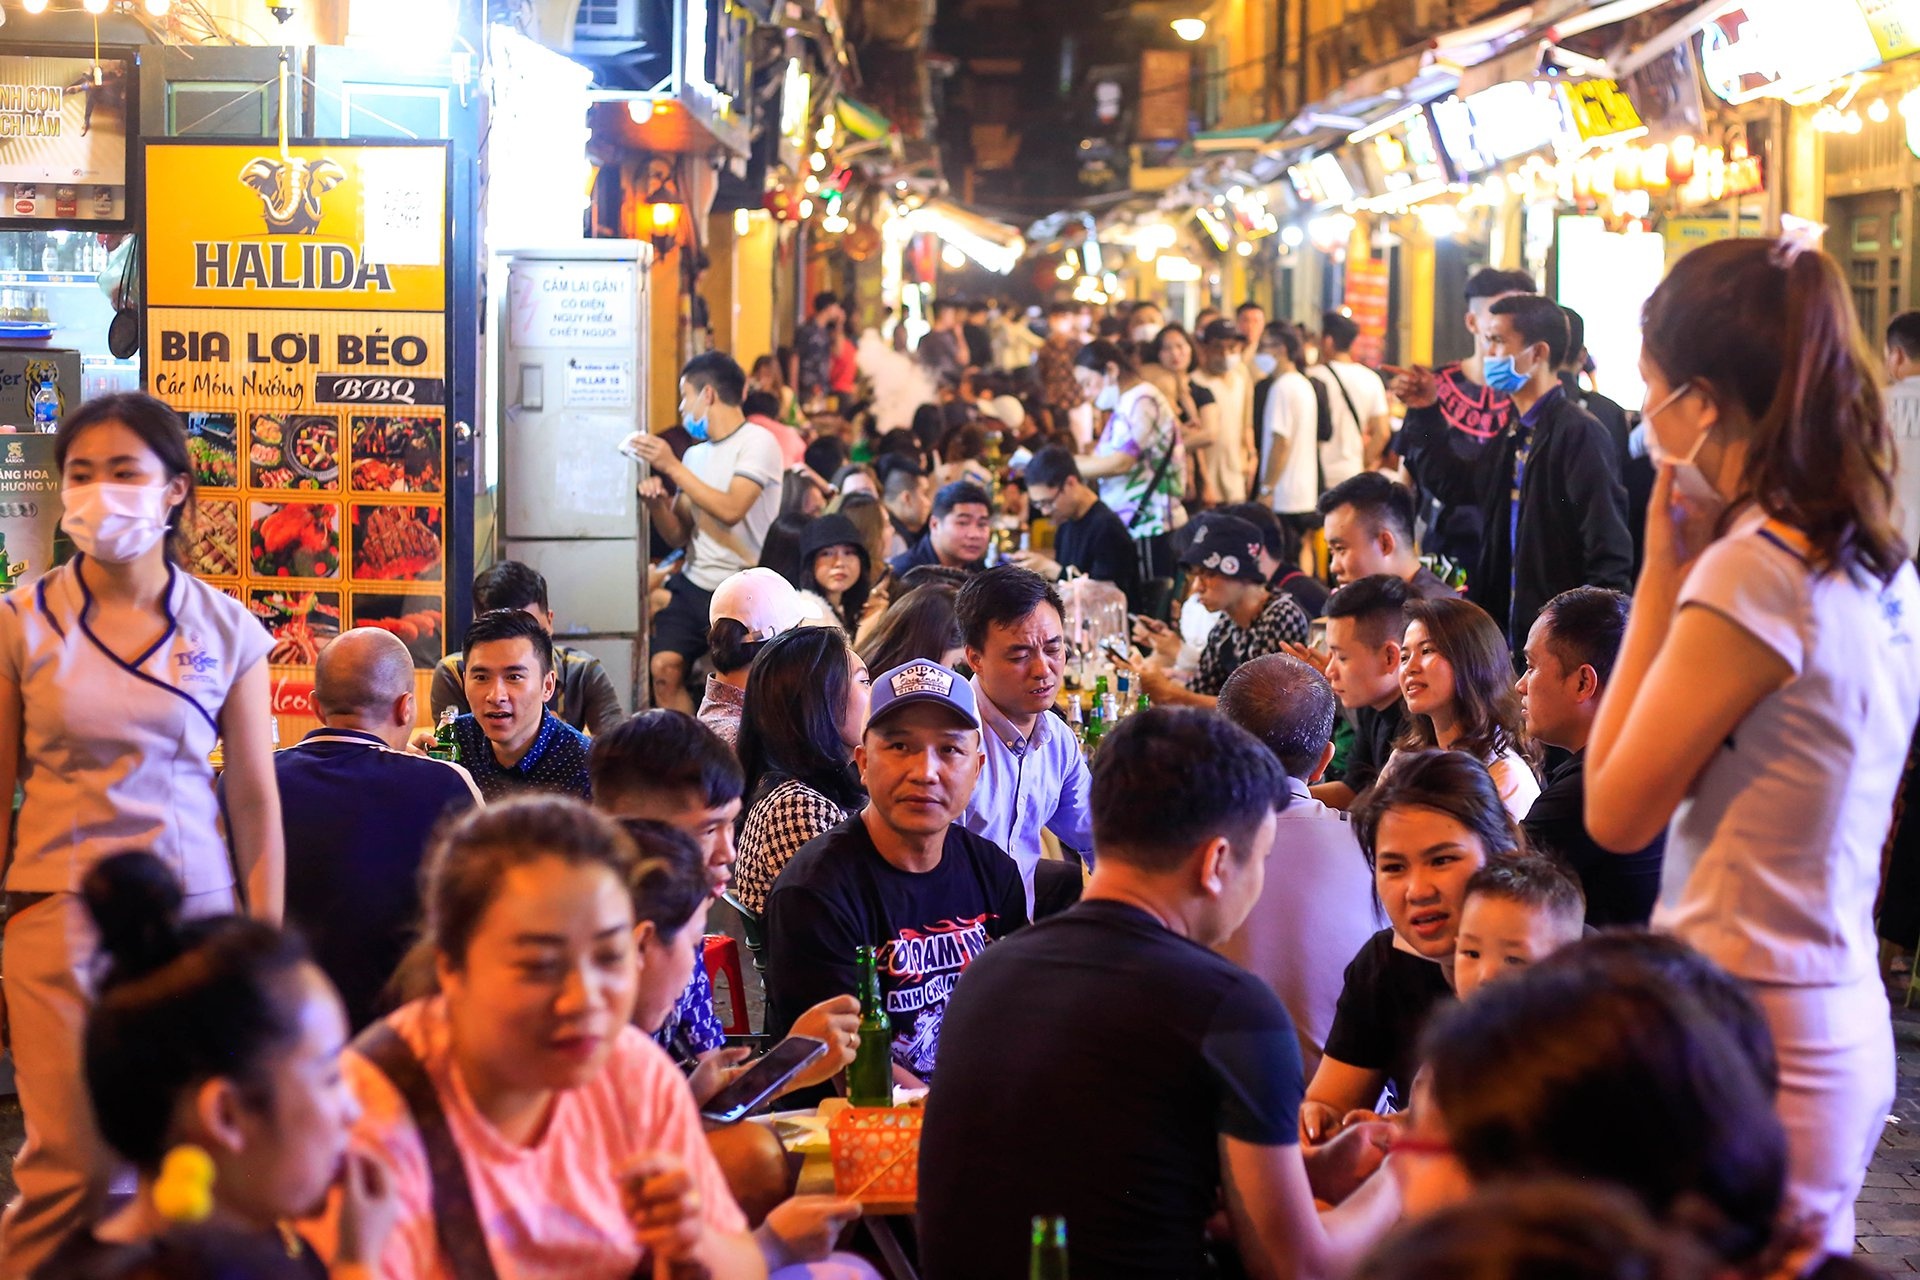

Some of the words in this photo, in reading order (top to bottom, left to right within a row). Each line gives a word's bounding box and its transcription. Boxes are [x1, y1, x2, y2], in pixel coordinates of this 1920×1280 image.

[193, 241, 396, 292] HALIDA
[161, 331, 230, 362] BIA
[338, 328, 428, 366] BÉO
[155, 373, 186, 396] Các
[193, 372, 235, 398] Món
[242, 370, 304, 410] Nướng
[332, 378, 416, 405] BBQ
[24, 469, 49, 480] HOA
[899, 666, 944, 679] ADIDAS
[887, 986, 925, 1012] ANH
